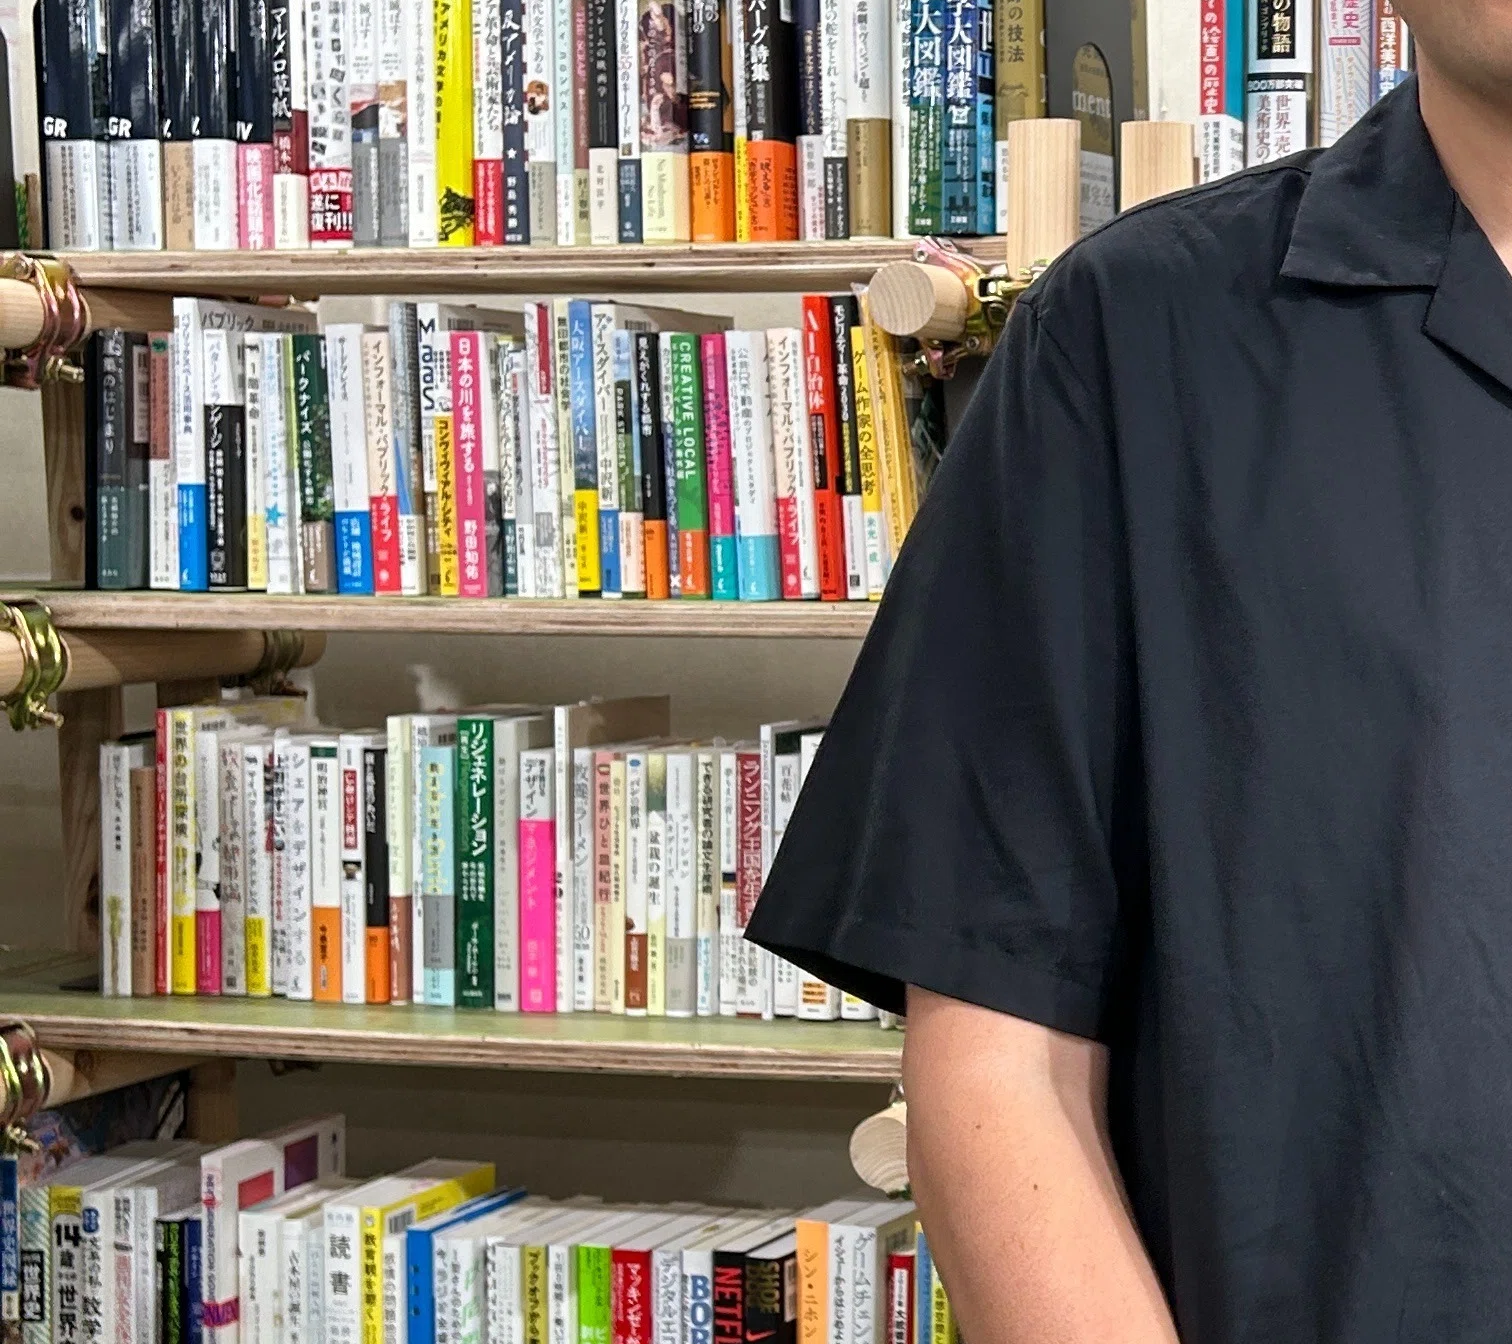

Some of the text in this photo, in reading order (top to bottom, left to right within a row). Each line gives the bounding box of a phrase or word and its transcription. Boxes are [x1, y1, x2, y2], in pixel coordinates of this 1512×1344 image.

[271, 7, 292, 118] マルメロ草紙
[43, 117, 68, 138] GR
[108, 117, 132, 138] GR
[294, 347, 315, 435] パークナイズ
[419, 316, 438, 413] MaaS
[457, 336, 476, 474] 日本の川を旅する
[570, 316, 586, 450] 大阪アースダイバー
[593, 311, 611, 416] アースダイバー
[639, 335, 653, 438] 見えがくれする都市
[678, 340, 698, 480] CREATIVE LOCAL
[854, 348, 876, 496] ゲーム作家の全思考
[463, 519, 480, 581] 野田知佑
[470, 723, 488, 857] リジェネレーション
[329, 1233, 352, 1296] 読書
[802, 1248, 818, 1338] シン・ニホン
